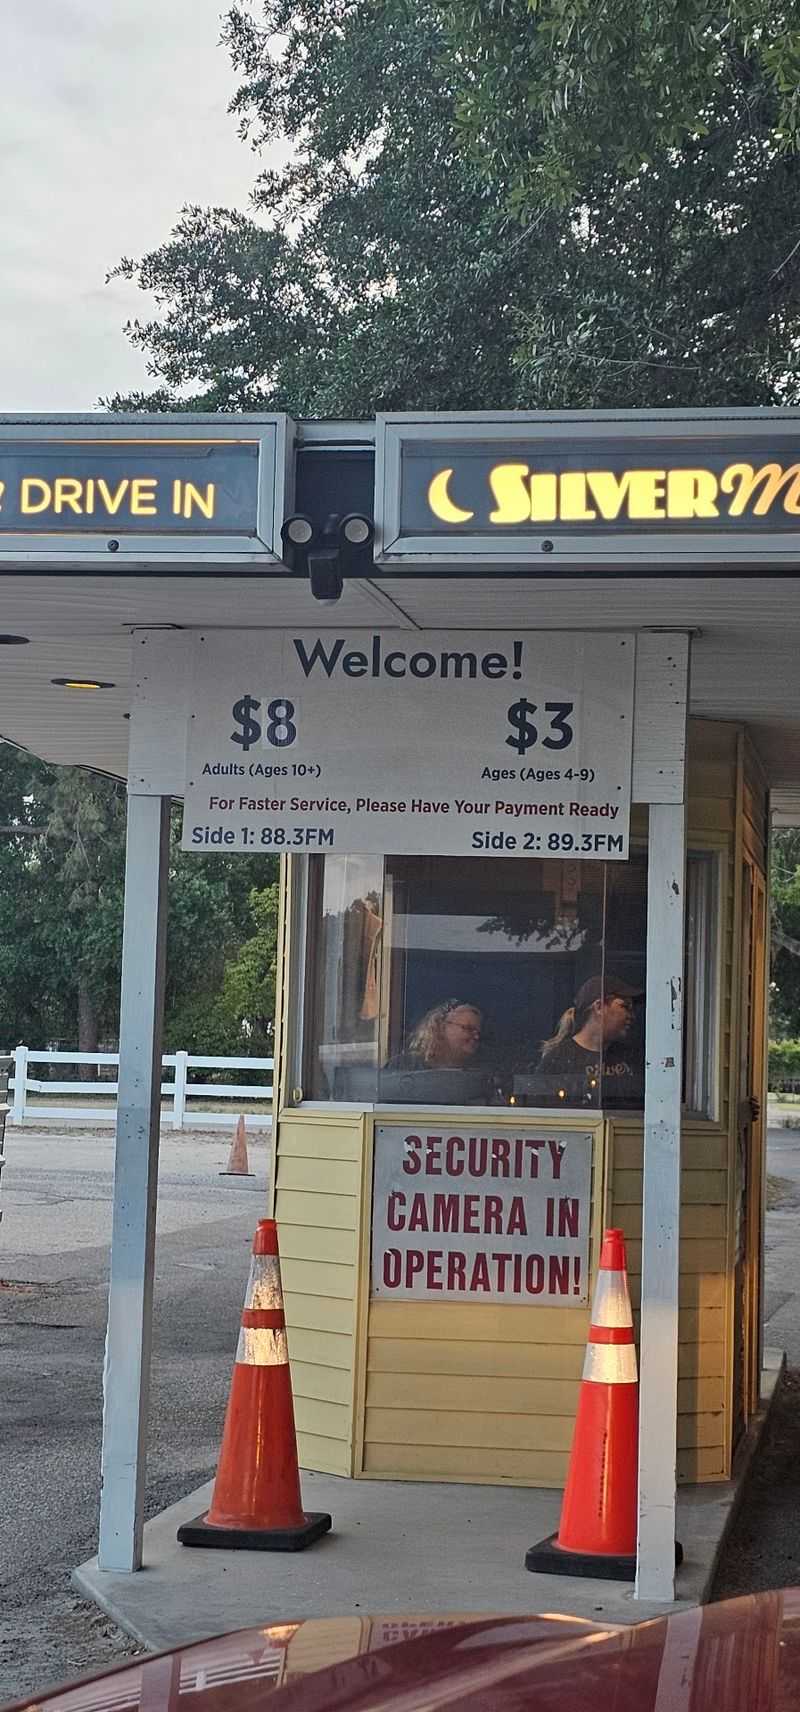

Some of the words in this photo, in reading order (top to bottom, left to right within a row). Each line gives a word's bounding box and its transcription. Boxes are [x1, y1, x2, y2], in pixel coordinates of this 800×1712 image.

[21, 478, 158, 515] DRIVE
[172, 479, 216, 519] IN
[293, 635, 523, 680] Welcome!
[230, 695, 297, 751] $8
[505, 698, 574, 755] $3
[202, 763, 245, 776] Adults
[249, 764, 288, 778] (Ages
[292, 764, 321, 778] 10+)
[481, 767, 516, 782] Ages
[519, 768, 561, 782] (Ages
[564, 768, 595, 783] 4-9)
[209, 796, 235, 810] For
[239, 797, 286, 811] Faster
[290, 797, 351, 814] Service,
[356, 798, 406, 813] Please
[411, 800, 449, 813] Have
[454, 800, 491, 815] Your
[495, 801, 564, 817] Payment
[569, 802, 619, 819] Ready
[192, 826, 236, 845] Side
[241, 827, 255, 845] 1:
[260, 828, 334, 846] 88.3FM
[471, 831, 517, 850] Side
[523, 832, 541, 850] 2:
[547, 833, 624, 852] 89.3FM
[402, 1135, 568, 1180] SECURITY
[387, 1191, 528, 1236] CAMERA
[545, 1195, 580, 1238] IN
[383, 1248, 581, 1296] OPERATION!
